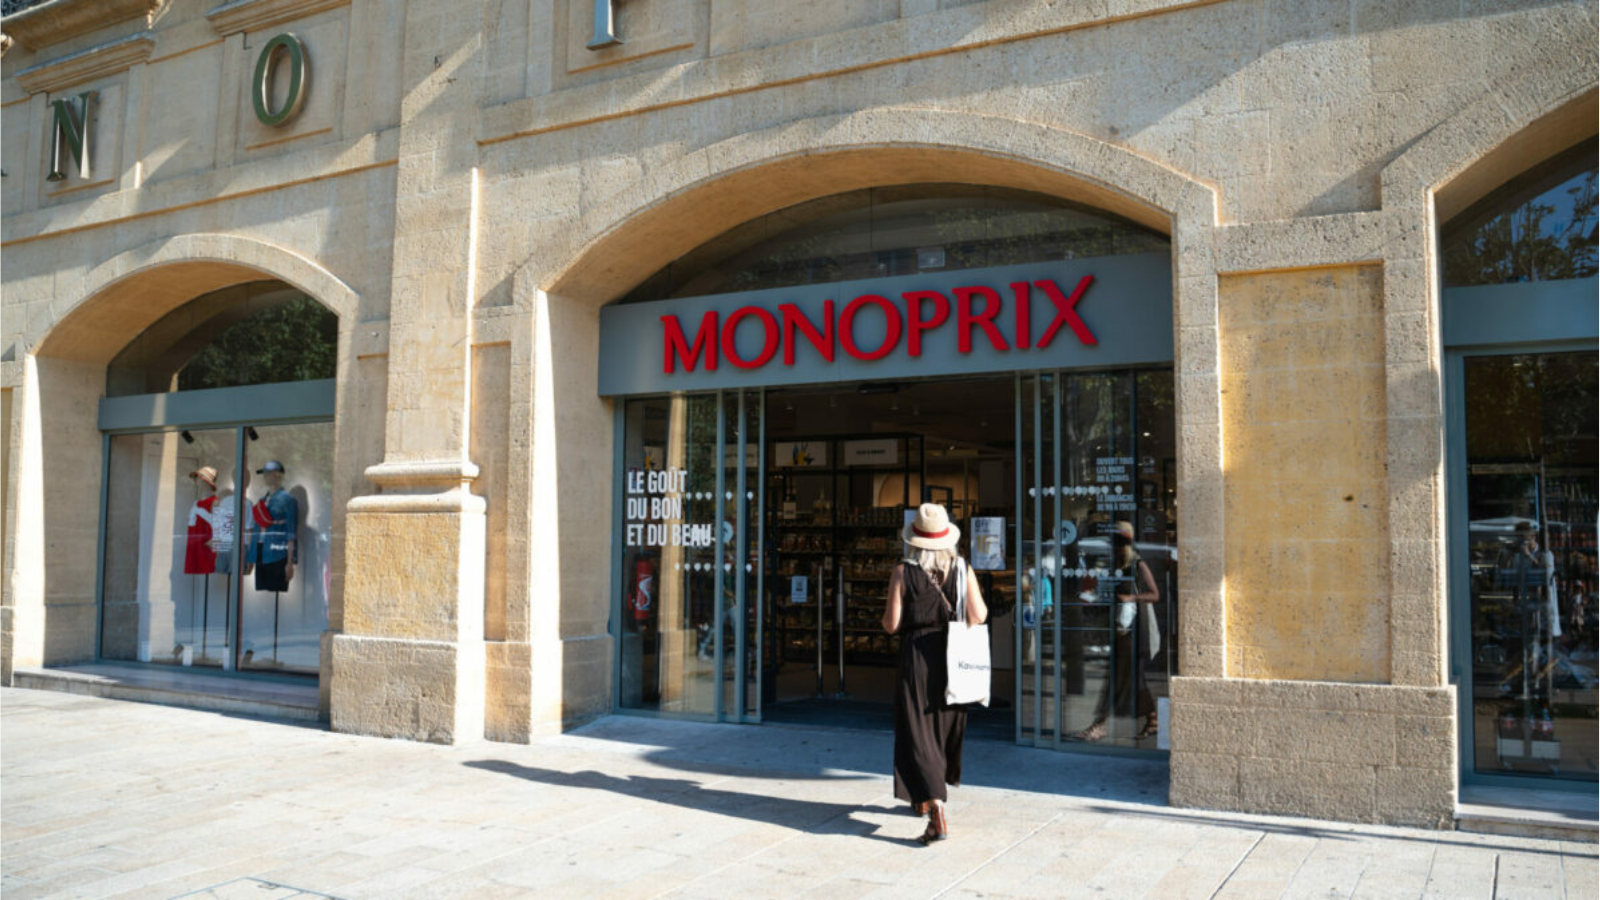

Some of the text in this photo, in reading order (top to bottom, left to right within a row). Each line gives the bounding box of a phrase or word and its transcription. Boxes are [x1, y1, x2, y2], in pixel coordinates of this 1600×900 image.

[47, 32, 309, 182] N O
[660, 275, 1098, 374] MONOPRIX
[628, 466, 688, 493] LE GOÛT
[627, 497, 682, 520] DU BON
[627, 523, 712, 547] ET DU BEAU
